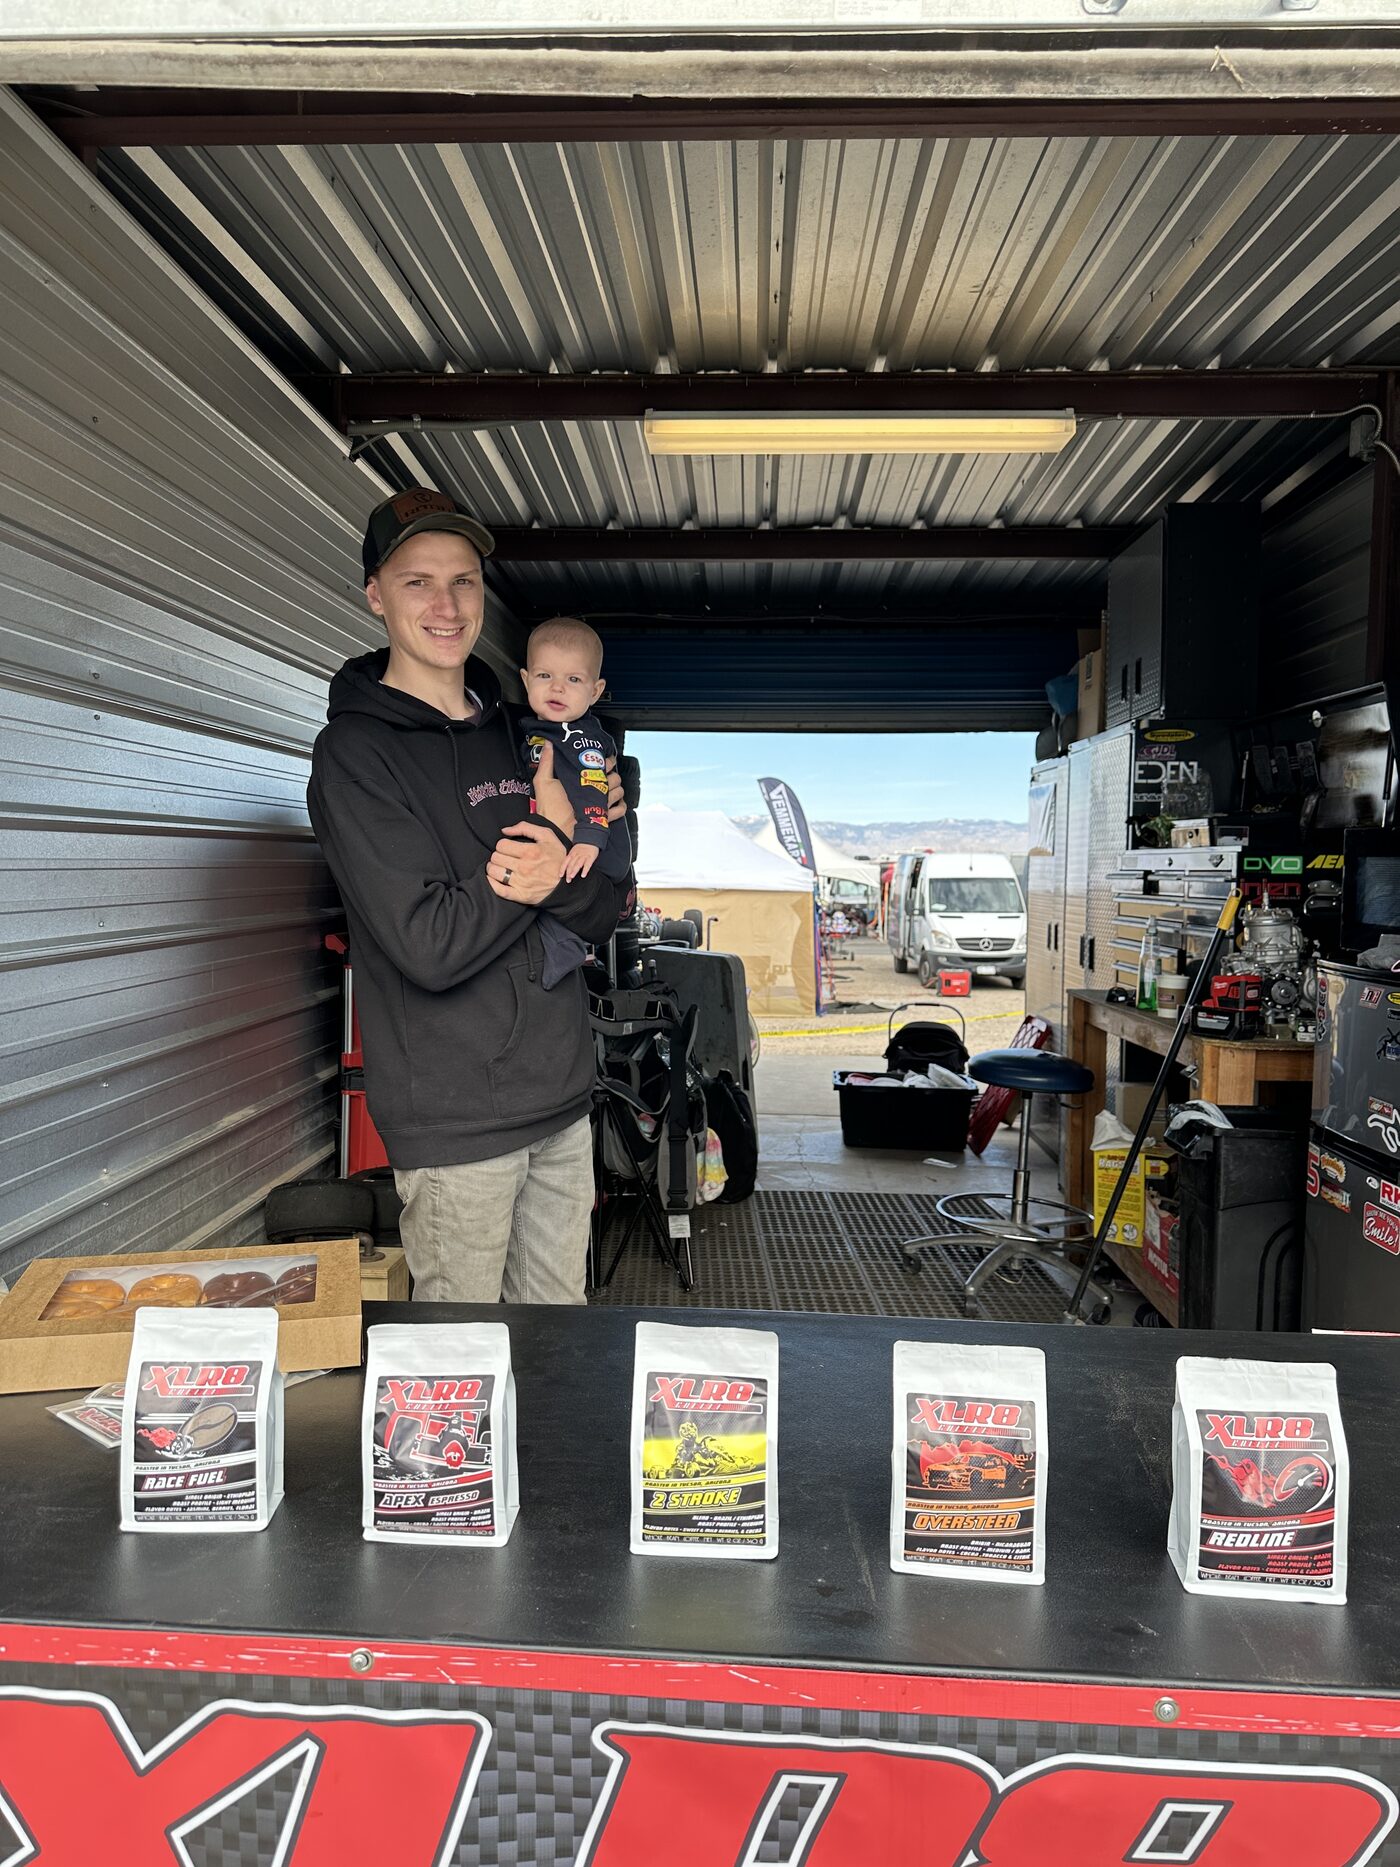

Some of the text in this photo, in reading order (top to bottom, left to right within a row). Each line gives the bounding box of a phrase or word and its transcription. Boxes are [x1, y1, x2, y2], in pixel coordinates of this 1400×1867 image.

[573, 737, 604, 750] citrix
[584, 753, 604, 766] Esso
[1134, 761, 1199, 784] EDEN
[1243, 857, 1300, 870] DVO
[1365, 1217, 1399, 1249] Smile!
[142, 1365, 250, 1398] XLR8
[380, 1379, 482, 1411] XLR8
[650, 1377, 755, 1410] XLR8
[911, 1398, 1022, 1433] XLR8
[1205, 1414, 1315, 1449] XLR8
[143, 1470, 226, 1490] RACE FUEL
[380, 1490, 480, 1507] APEX ESPRESSO
[651, 1488, 741, 1508] 2 STROKE
[913, 1512, 1021, 1530] OVERSTEER
[1208, 1531, 1296, 1547] REDLINE
